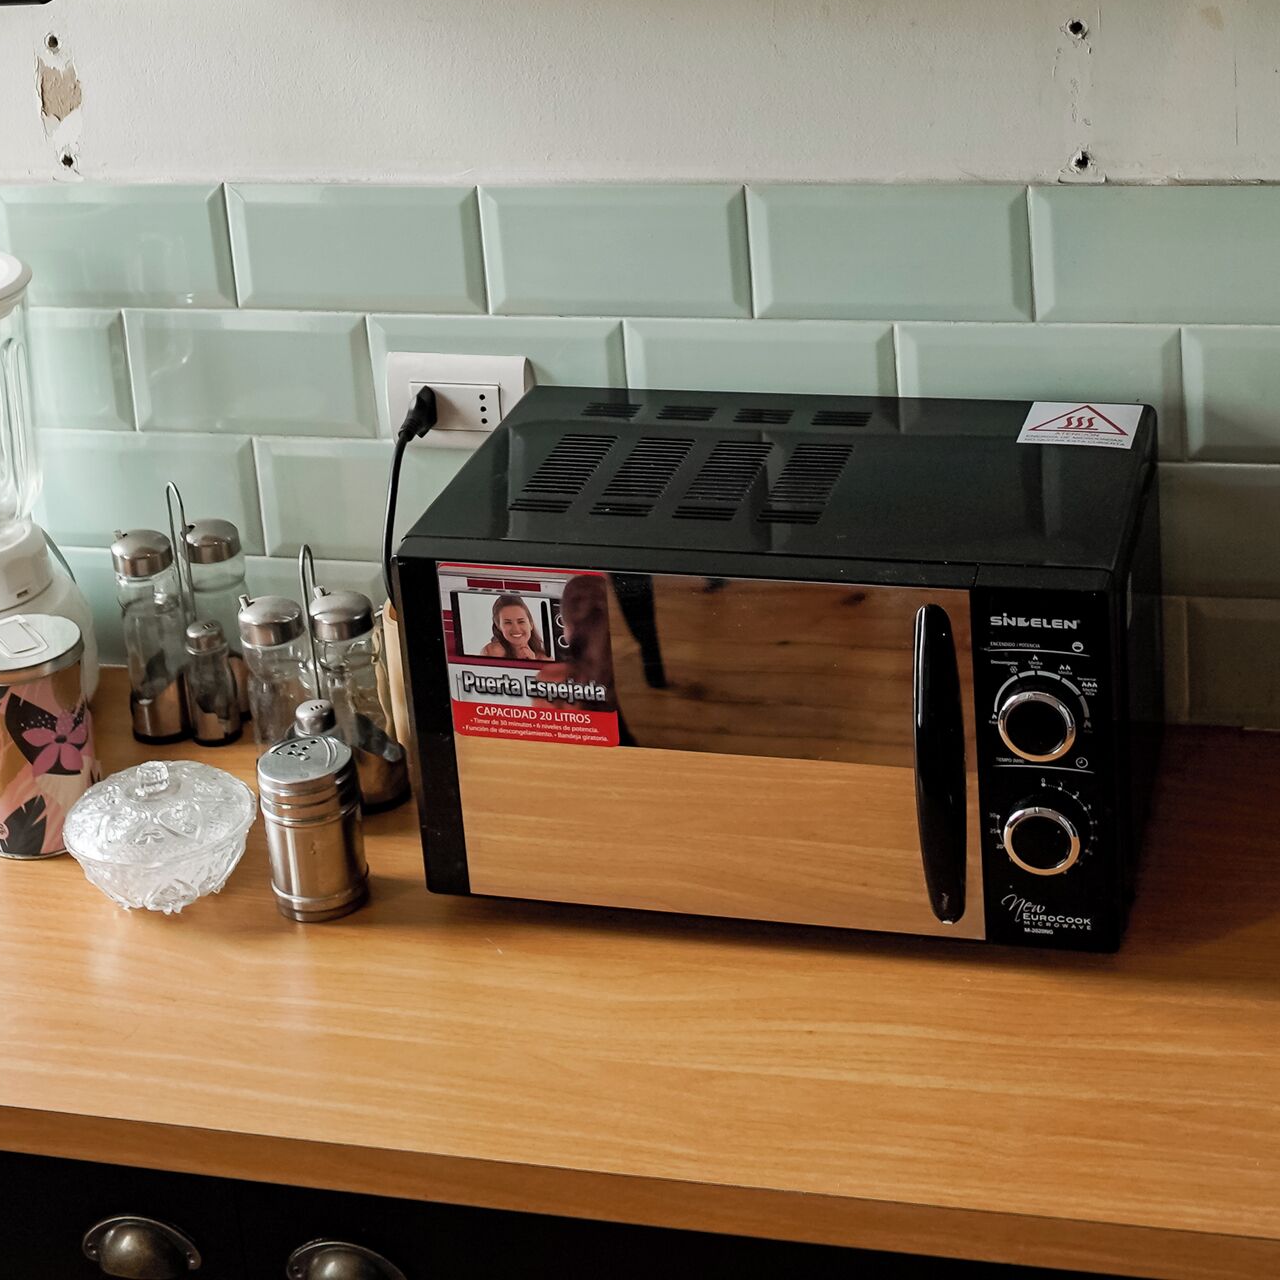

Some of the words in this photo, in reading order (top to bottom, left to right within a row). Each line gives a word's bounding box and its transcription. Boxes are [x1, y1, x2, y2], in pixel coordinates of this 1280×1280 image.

[461, 671, 523, 698] Puerta
[525, 675, 608, 703] Espejada
[476, 705, 537, 720] CAPACIDAD
[539, 711, 552, 721] 20
[554, 712, 591, 724] LITROS
[508, 720, 533, 728] minutos
[541, 723, 562, 731] niveles
[557, 732, 581, 740] Bandeja
[1000, 893, 1046, 922] New
[1023, 920, 1093, 931] MICROWAVE
